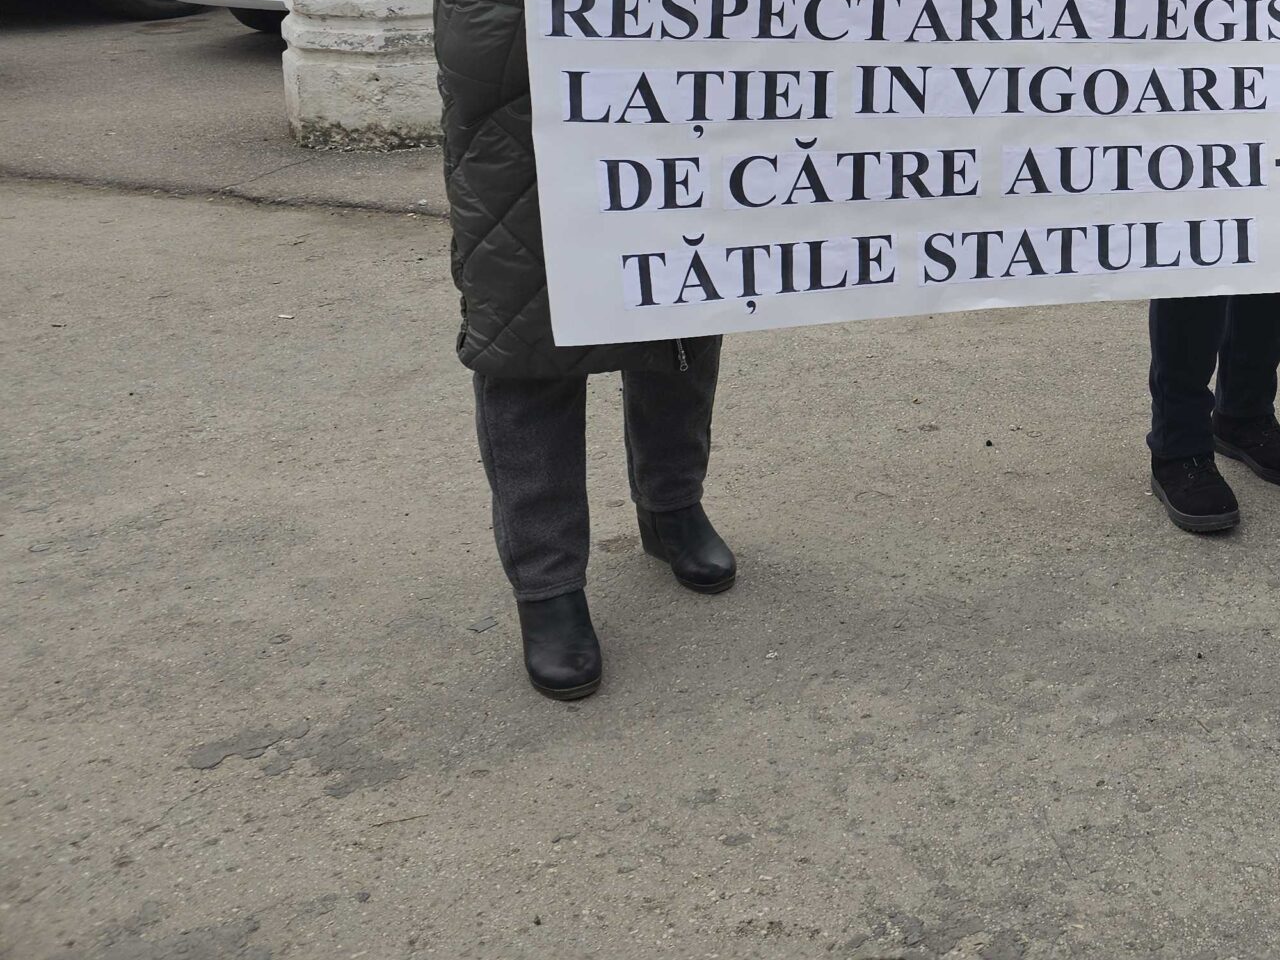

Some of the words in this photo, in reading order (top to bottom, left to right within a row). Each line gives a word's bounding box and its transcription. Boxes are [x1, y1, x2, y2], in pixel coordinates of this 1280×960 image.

[562, 70, 833, 138] LAȚIEI
[856, 66, 932, 113] IN
[951, 67, 1266, 115] VIGOARE
[600, 158, 704, 211] DE
[730, 138, 979, 208] CĂTRE
[622, 233, 896, 314] TĂȚILE
[924, 219, 1252, 283] STATULUI
